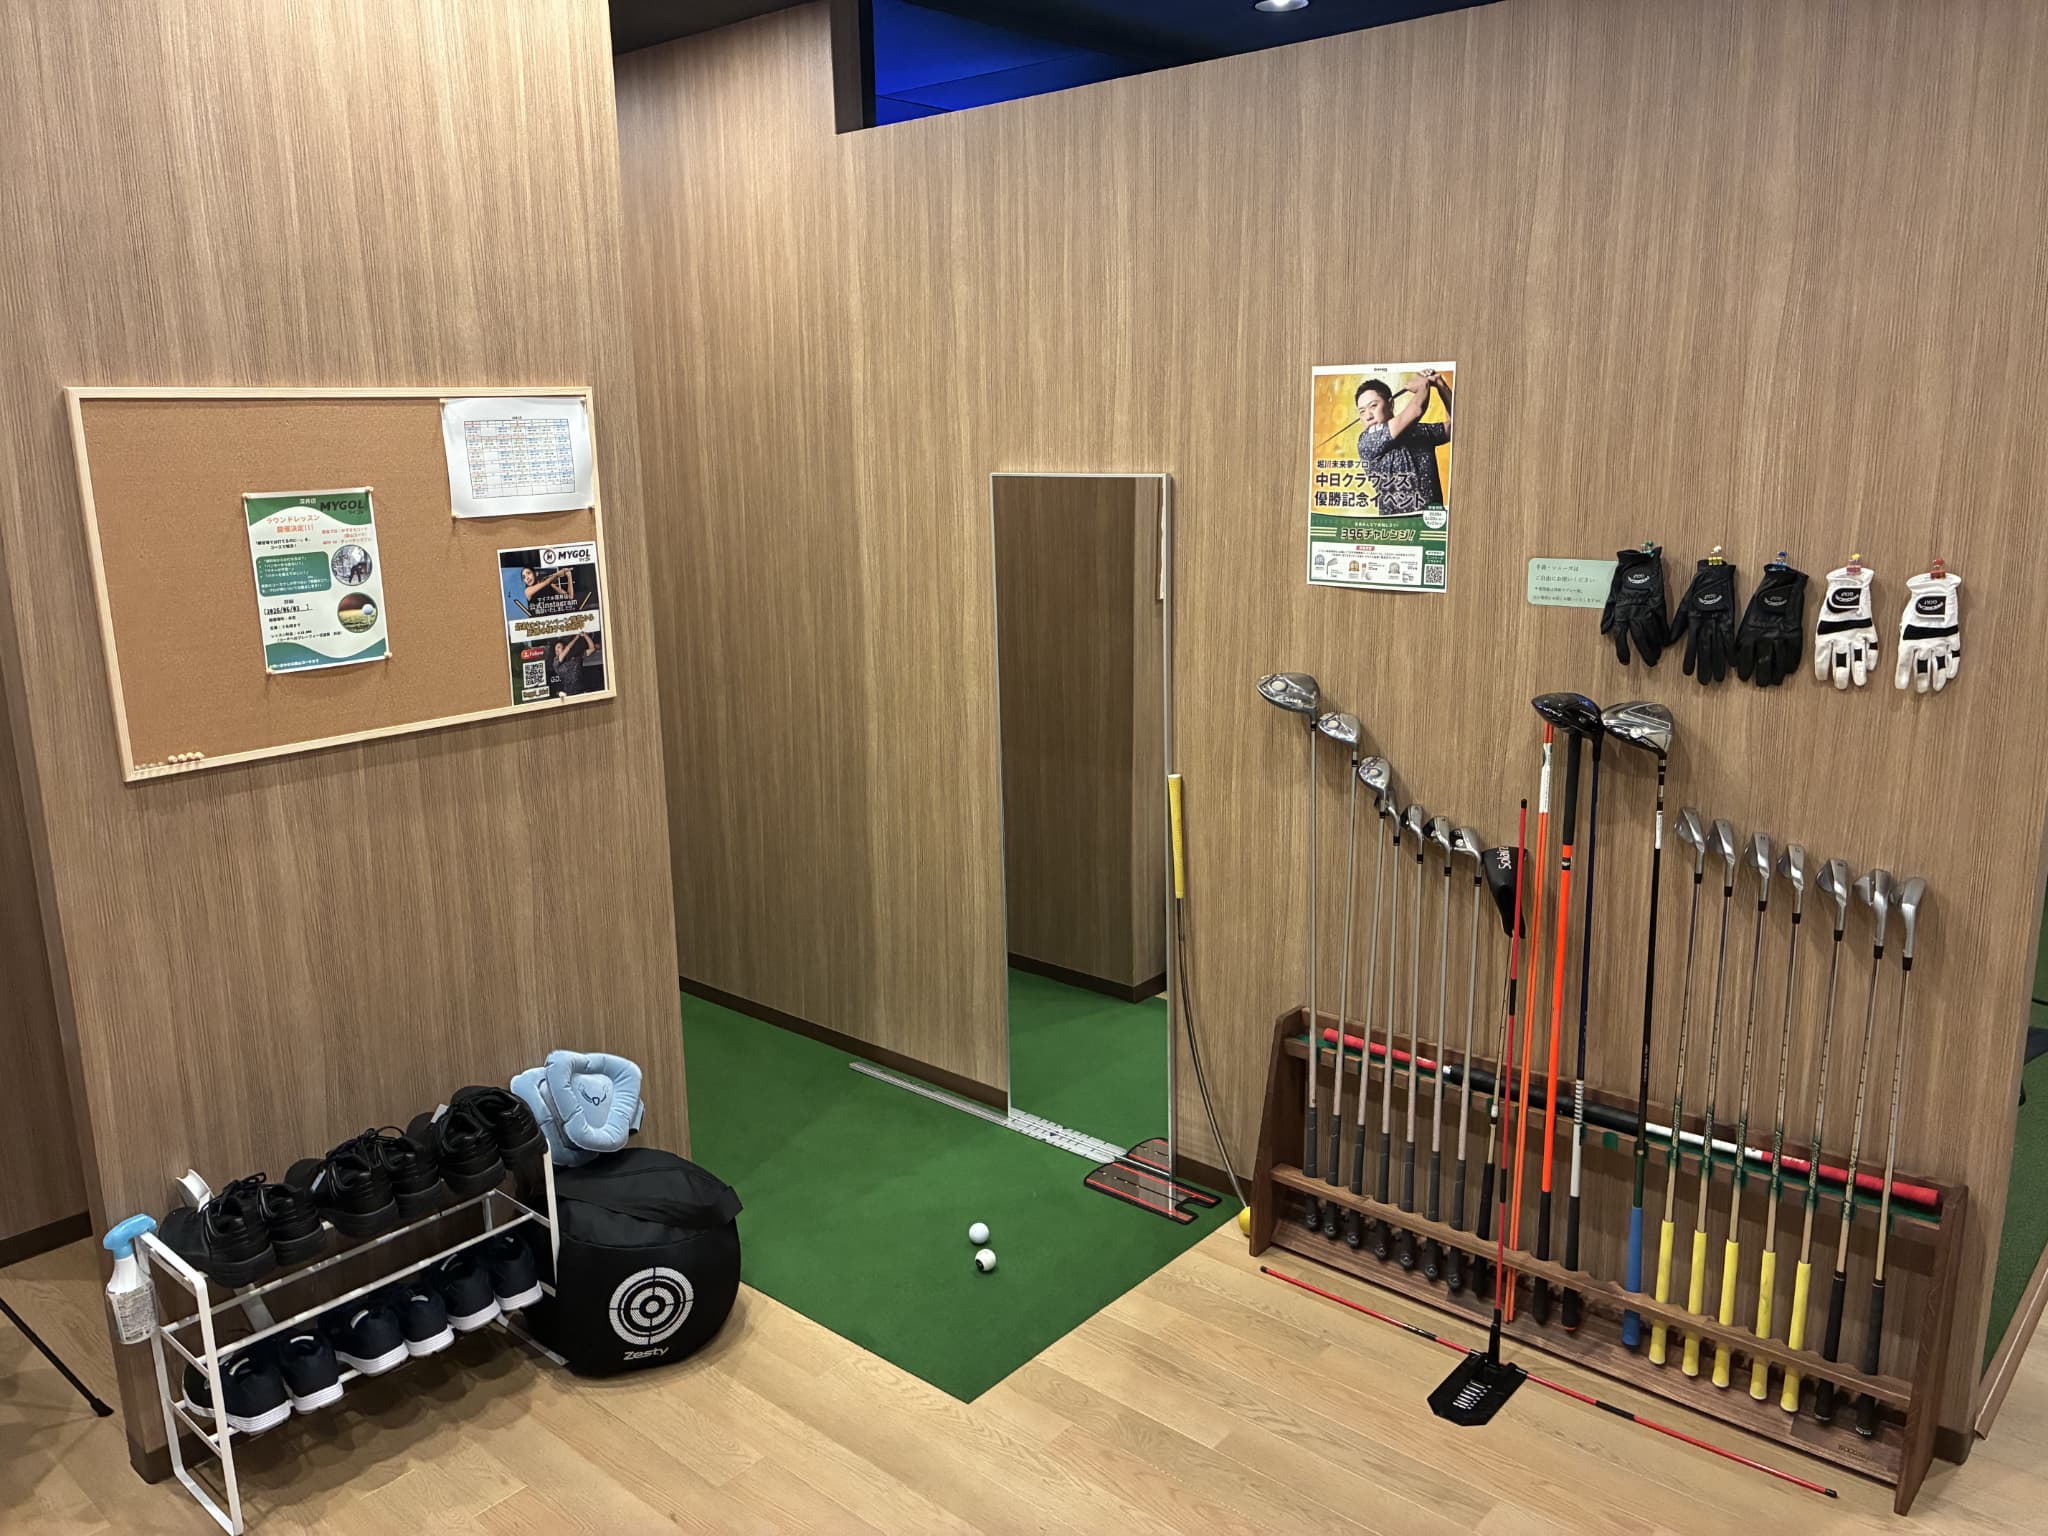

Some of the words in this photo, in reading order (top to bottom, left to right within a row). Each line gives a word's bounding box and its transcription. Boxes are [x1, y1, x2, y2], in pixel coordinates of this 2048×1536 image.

[320, 499, 364, 512] MYGOL
[1315, 491, 1426, 509] 優勝記念イベント
[266, 514, 321, 525] ラウンドレッスン
[558, 549, 591, 561] MYGOL
[623, 1347, 670, 1361] Zesty
